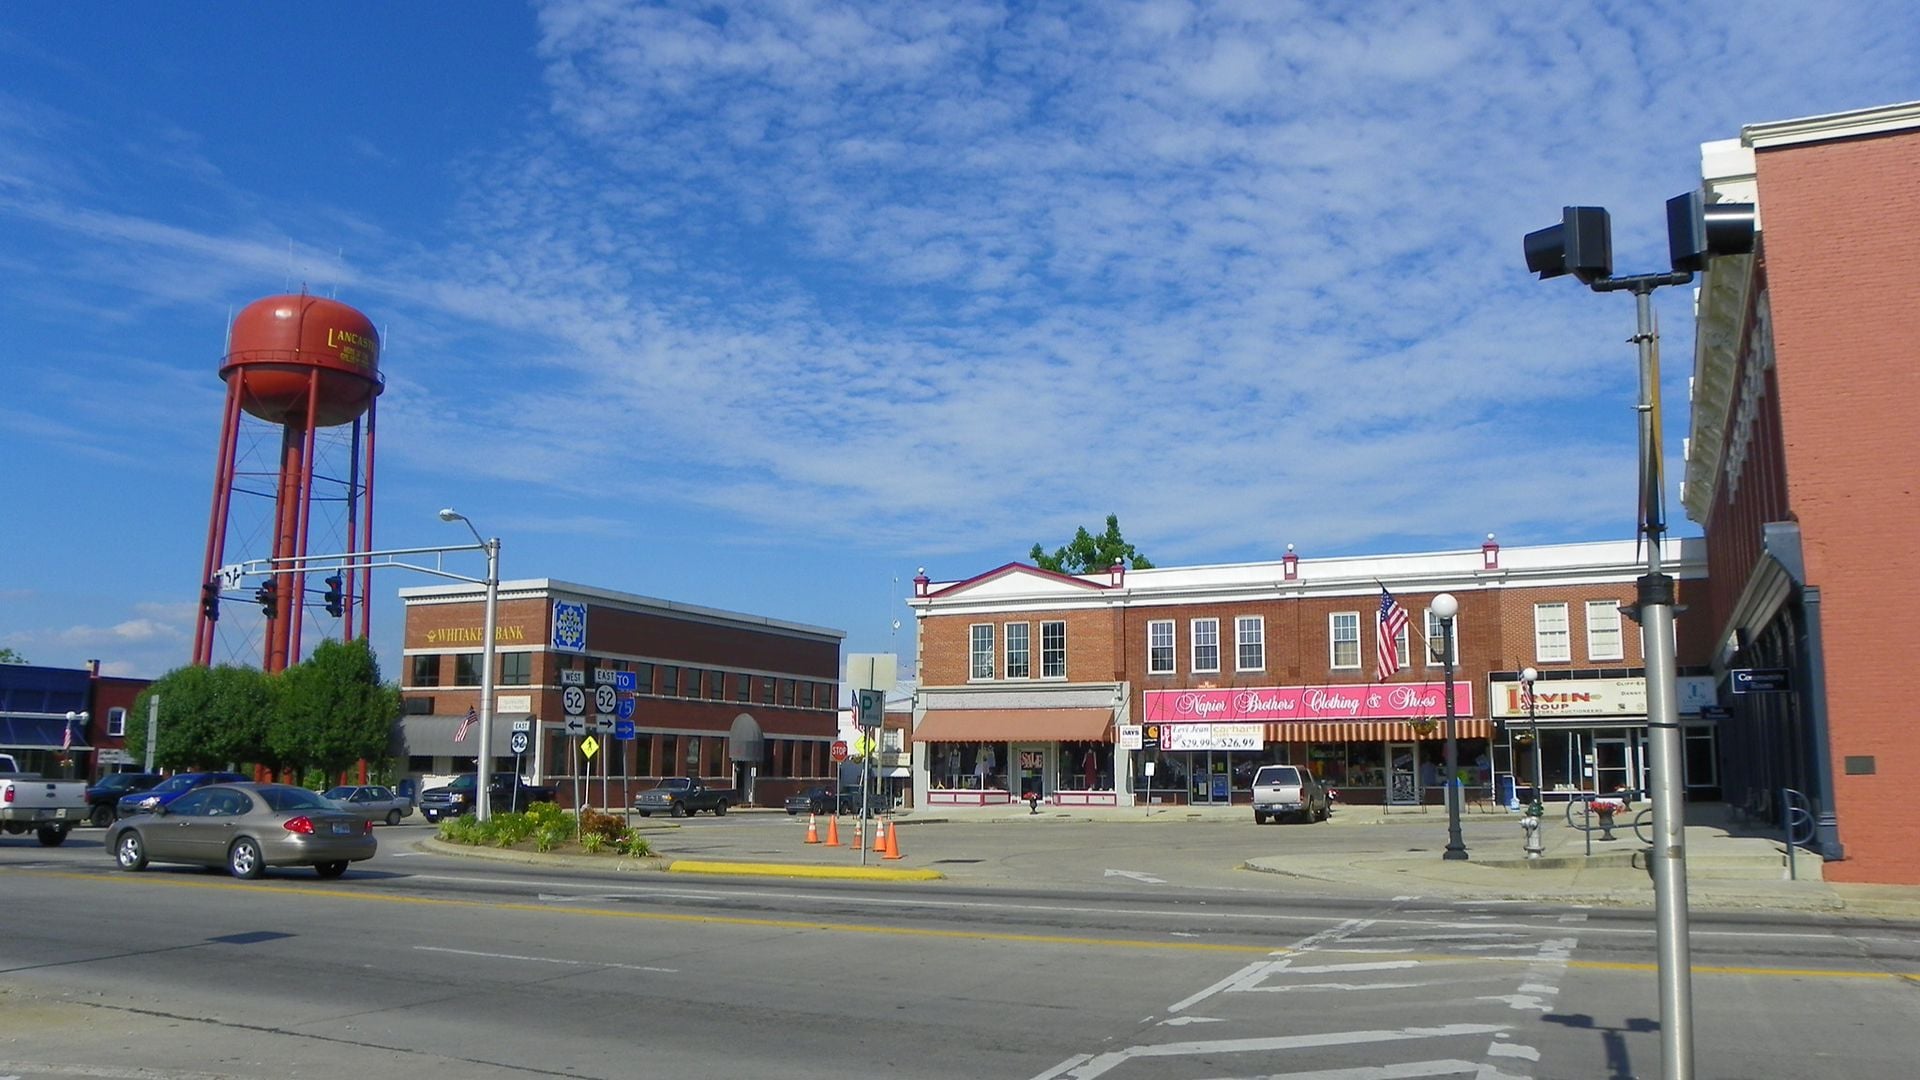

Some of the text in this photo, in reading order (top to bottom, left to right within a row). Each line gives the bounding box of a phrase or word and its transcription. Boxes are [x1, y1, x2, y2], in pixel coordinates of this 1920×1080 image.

[438, 625, 524, 641] WHITAKE BANK
[565, 672, 581, 682] WEST
[597, 670, 614, 680] EAST
[617, 676, 629, 686] TO
[566, 691, 582, 709] 52
[599, 690, 614, 708] 52
[1175, 686, 1436, 718] Napier Brothers Clothing & Shoes
[618, 700, 632, 713] 75
[862, 696, 872, 719] P
[1212, 725, 1260, 733] carhartt
[514, 736, 526, 748] 52
[1180, 738, 1210, 748] $29.99
[1221, 738, 1255, 748] $26.99
[832, 746, 847, 755] STOP
[1021, 752, 1043, 768] SALE
